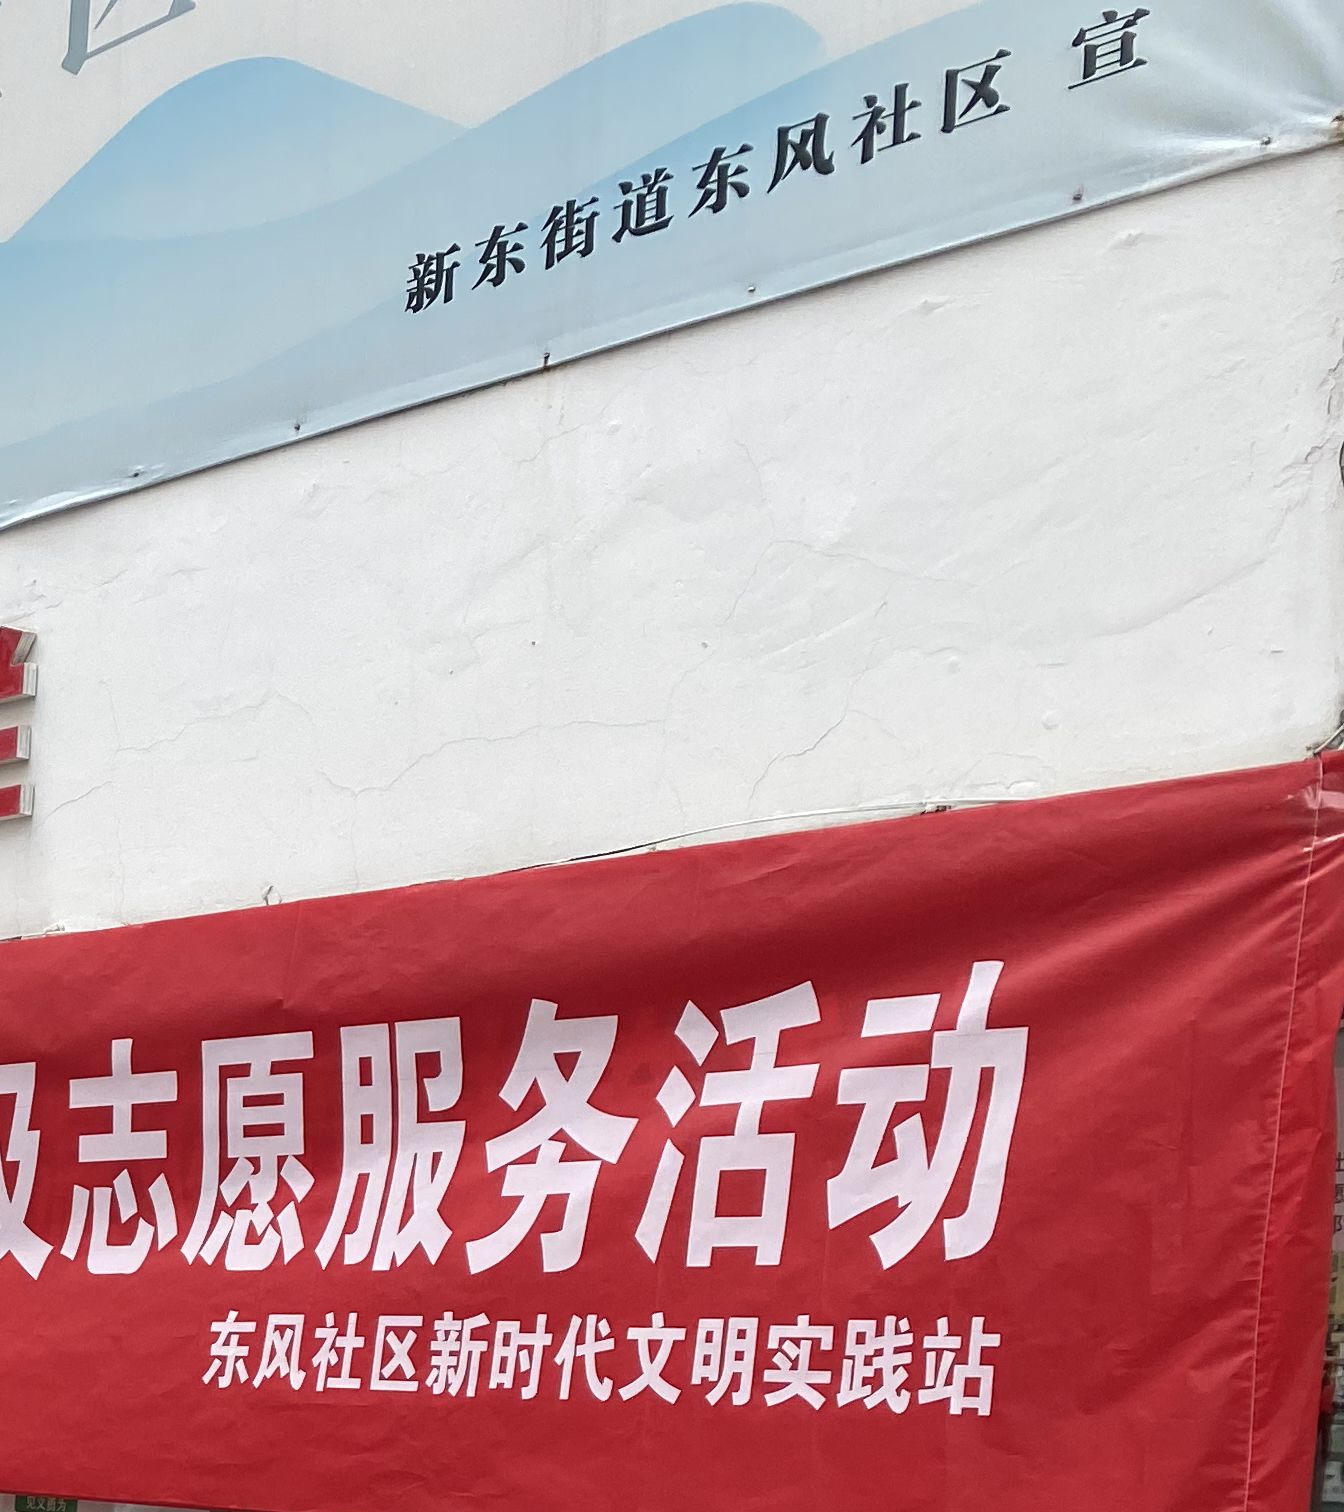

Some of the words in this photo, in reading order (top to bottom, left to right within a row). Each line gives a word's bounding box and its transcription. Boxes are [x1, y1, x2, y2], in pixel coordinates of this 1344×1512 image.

[404, 47, 1015, 315] 新东街道东风社区
[1068, 8, 1152, 91] 宣
[201, 1310, 1003, 1418] 东风社区新时代文明实践站
